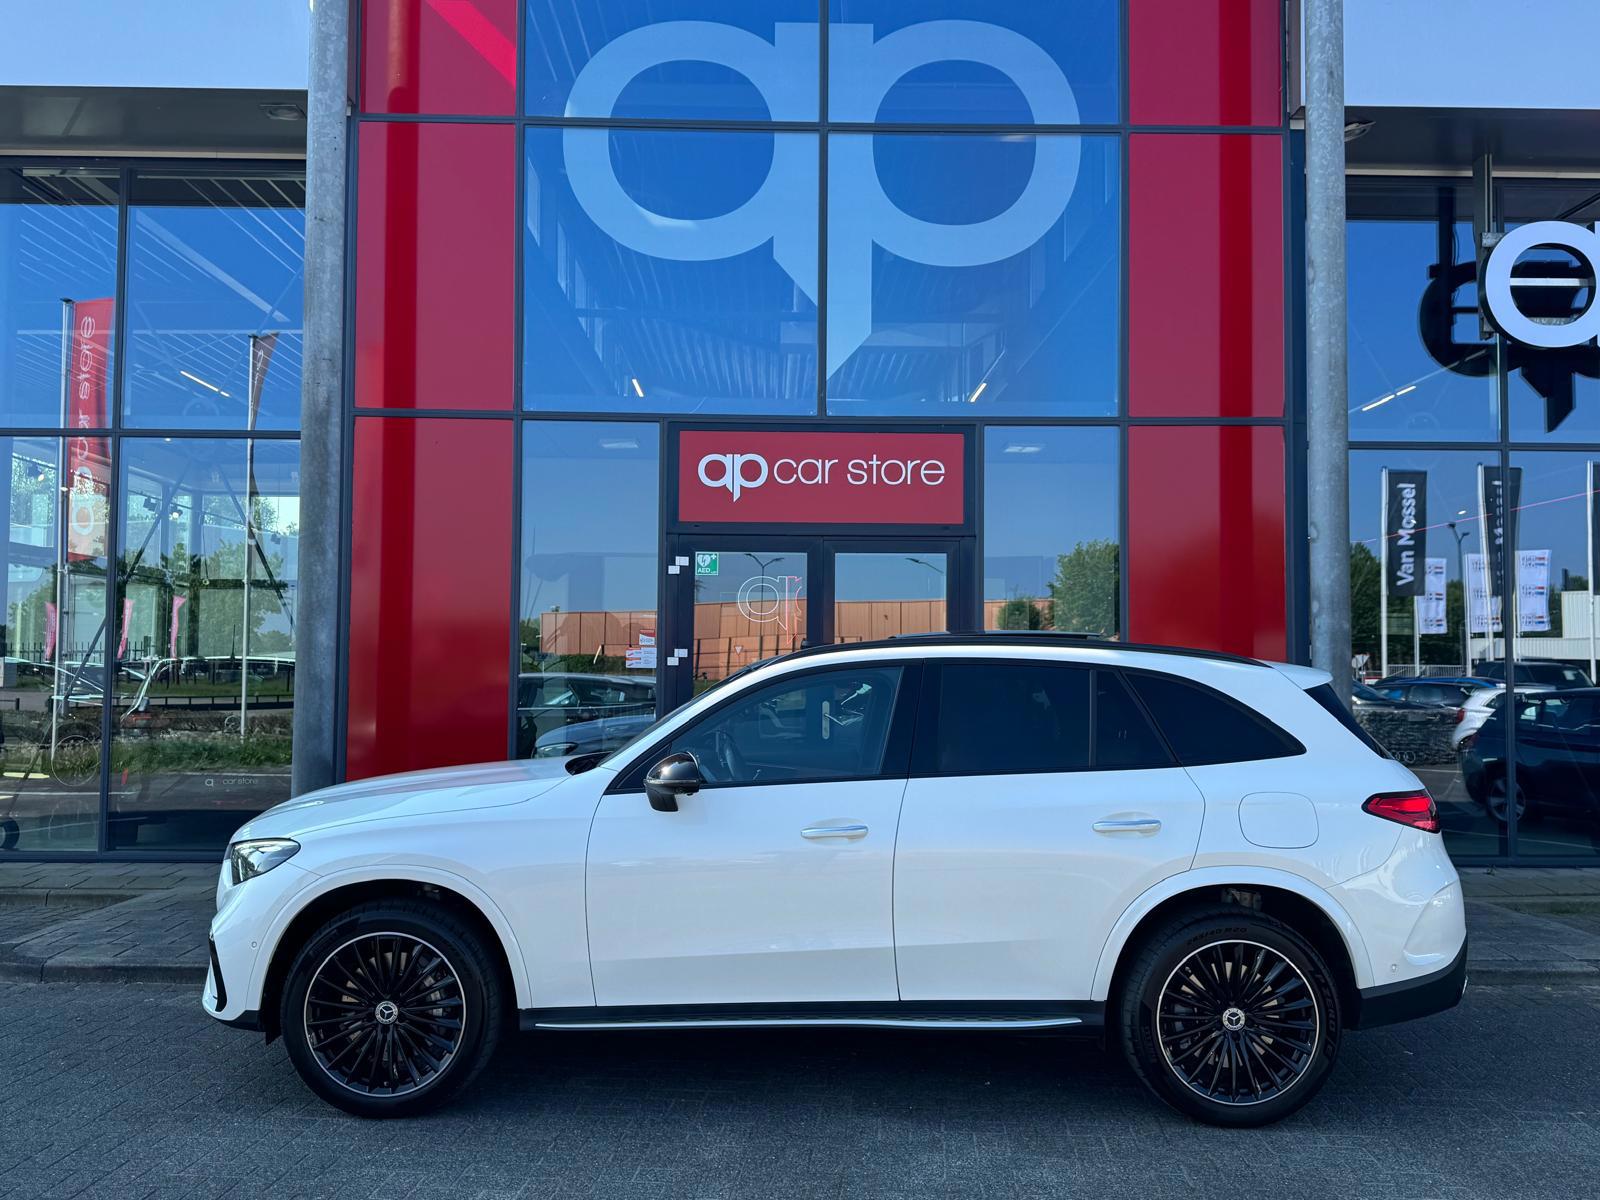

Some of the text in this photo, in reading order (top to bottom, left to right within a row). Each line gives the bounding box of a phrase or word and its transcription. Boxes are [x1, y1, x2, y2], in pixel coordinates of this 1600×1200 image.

[562, 19, 1082, 381] ap
[697, 452, 946, 503] ap car store
[1396, 483, 1417, 587] Van Mossel
